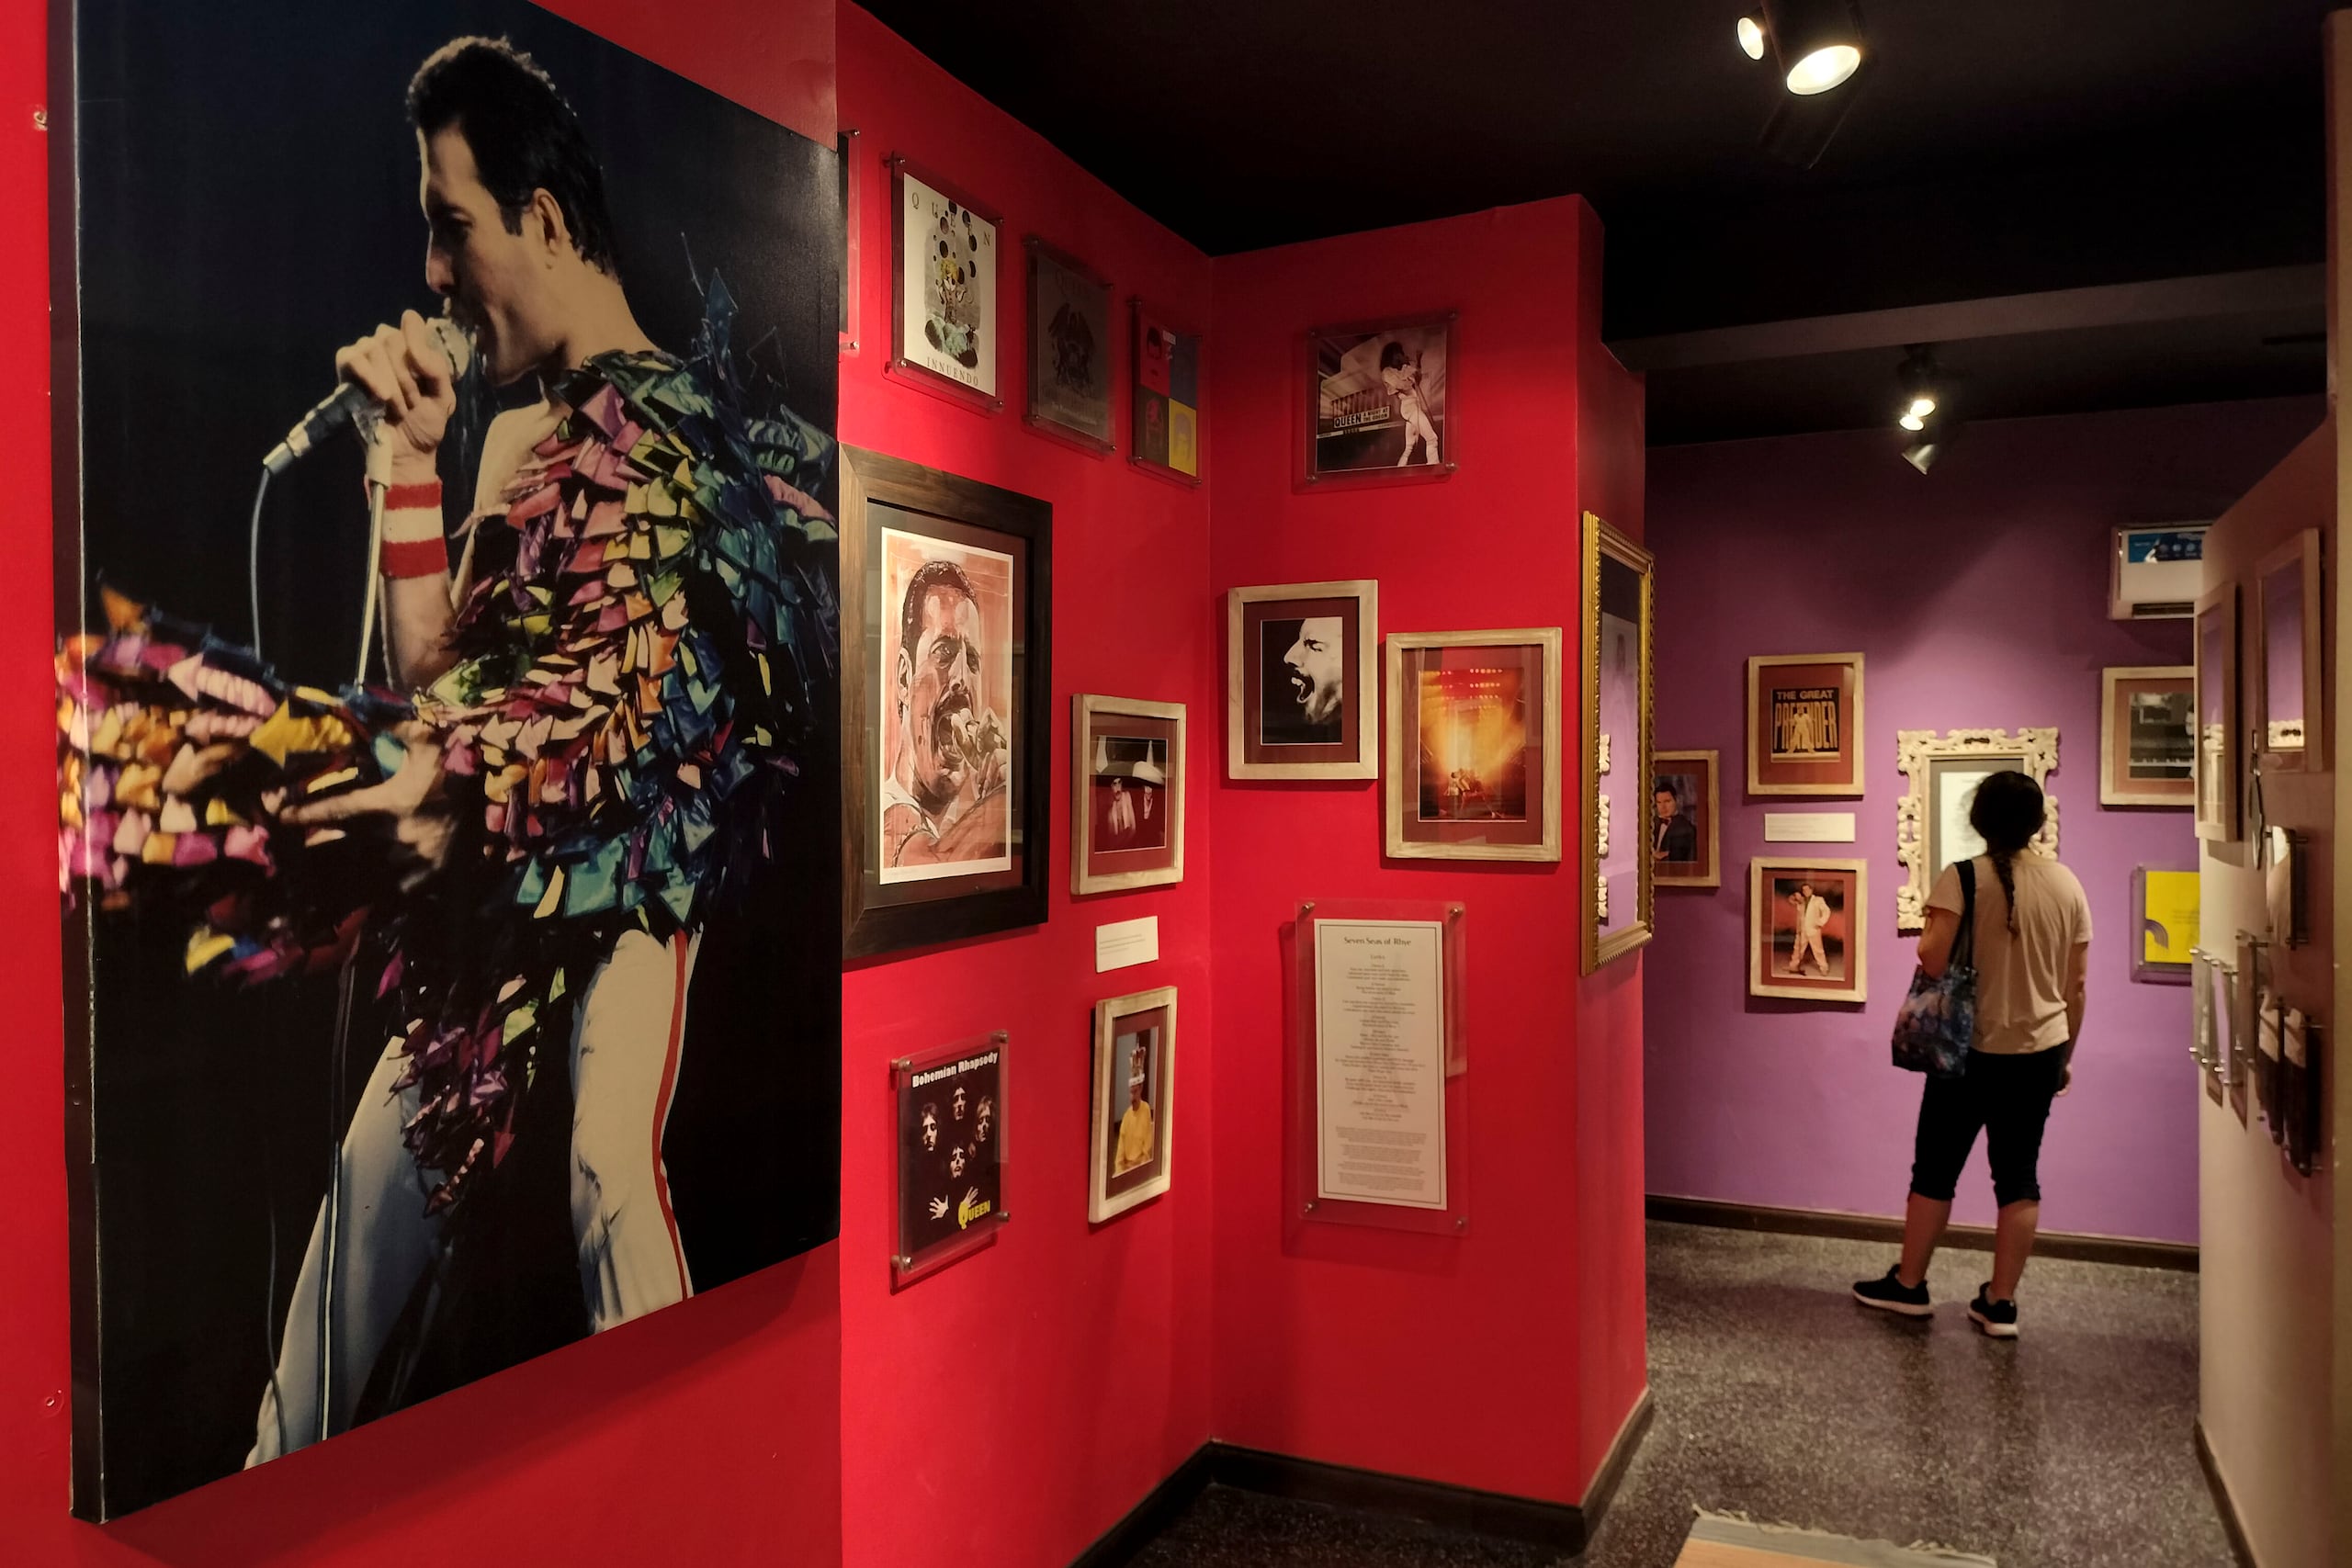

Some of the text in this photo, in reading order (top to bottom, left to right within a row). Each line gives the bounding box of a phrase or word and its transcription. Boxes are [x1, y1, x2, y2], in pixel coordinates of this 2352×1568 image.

[927, 356, 978, 386] INNUENDO
[1335, 413, 1362, 427] QUEEN
[1777, 689, 1835, 700] THE GREAT
[1774, 701, 1838, 750] PRENDER
[1343, 936, 1365, 945] Seven
[1365, 937, 1383, 945] Seas
[1393, 937, 1412, 947] Rhye
[912, 1051, 999, 1089] Bohemian Rhapsody
[958, 1200, 991, 1230] QUEEN
